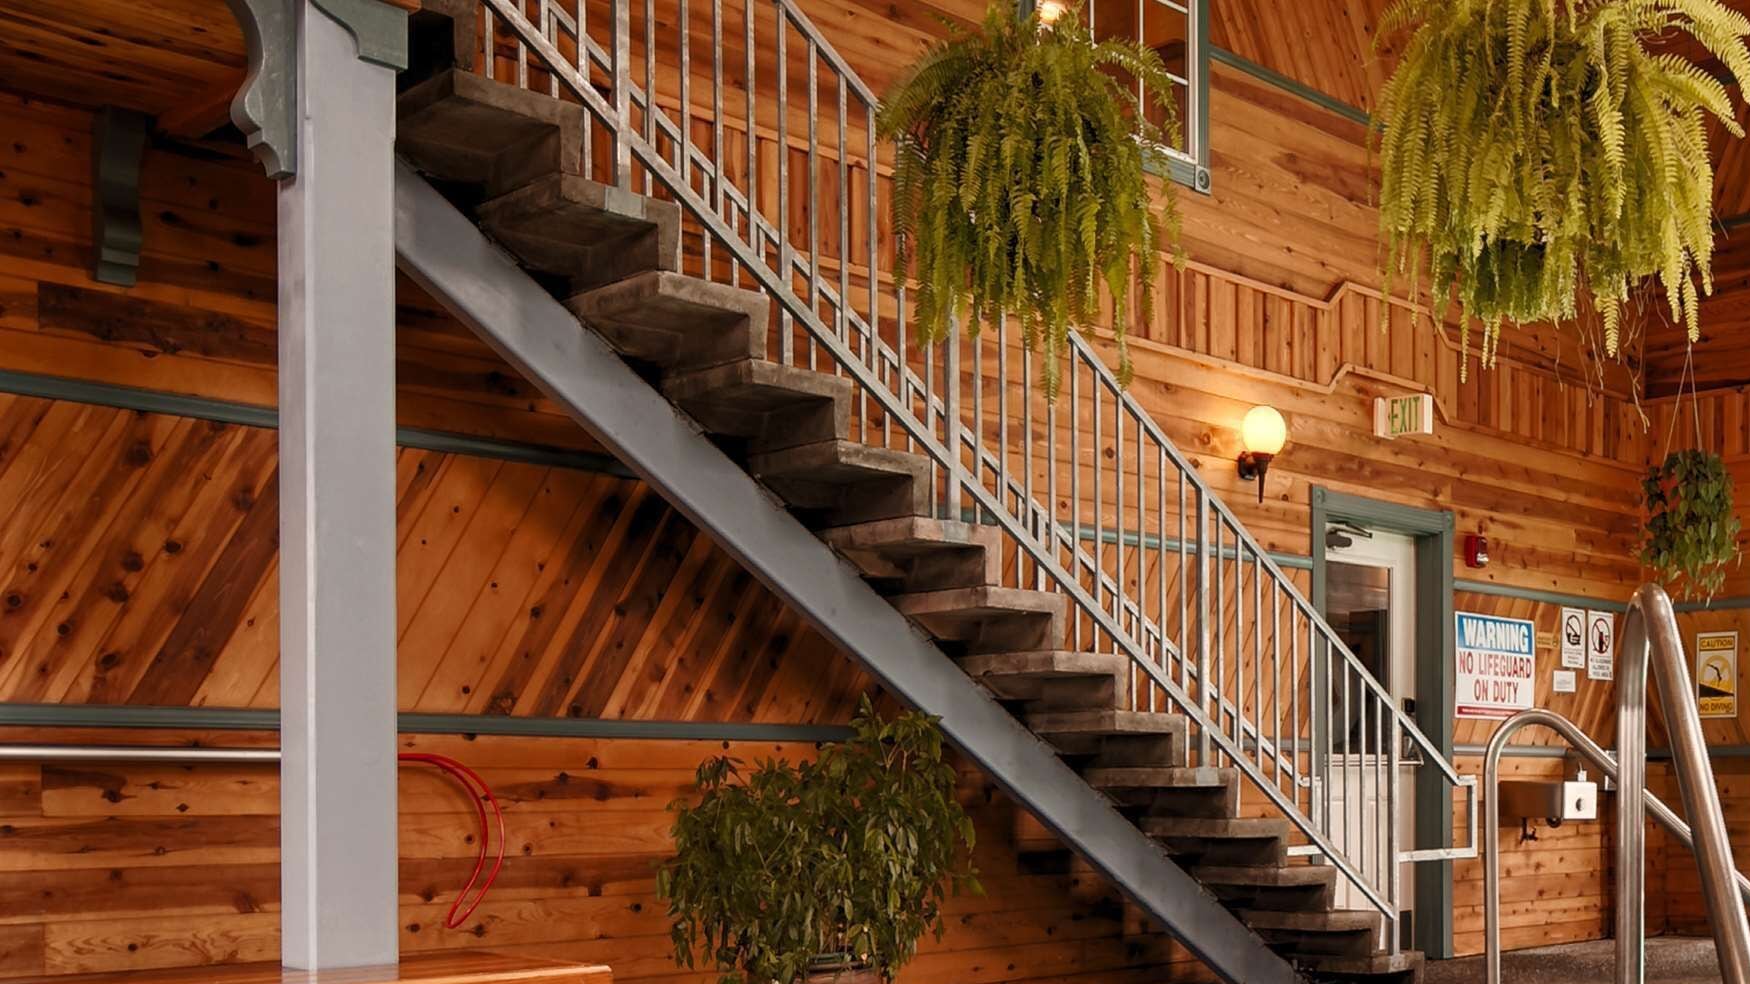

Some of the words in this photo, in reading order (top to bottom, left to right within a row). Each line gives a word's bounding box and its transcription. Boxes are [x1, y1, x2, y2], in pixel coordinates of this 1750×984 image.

[1391, 396, 1420, 433] EXIT
[1463, 618, 1529, 653] WARNING
[1701, 638, 1733, 649] CAUTION
[1459, 651, 1473, 674] NO
[1478, 653, 1532, 678] LIFEGUARD
[1474, 679, 1488, 701] ON
[1493, 680, 1518, 703] DUTY
[1700, 703, 1710, 712] NO
[1711, 702, 1733, 712] DIVING
